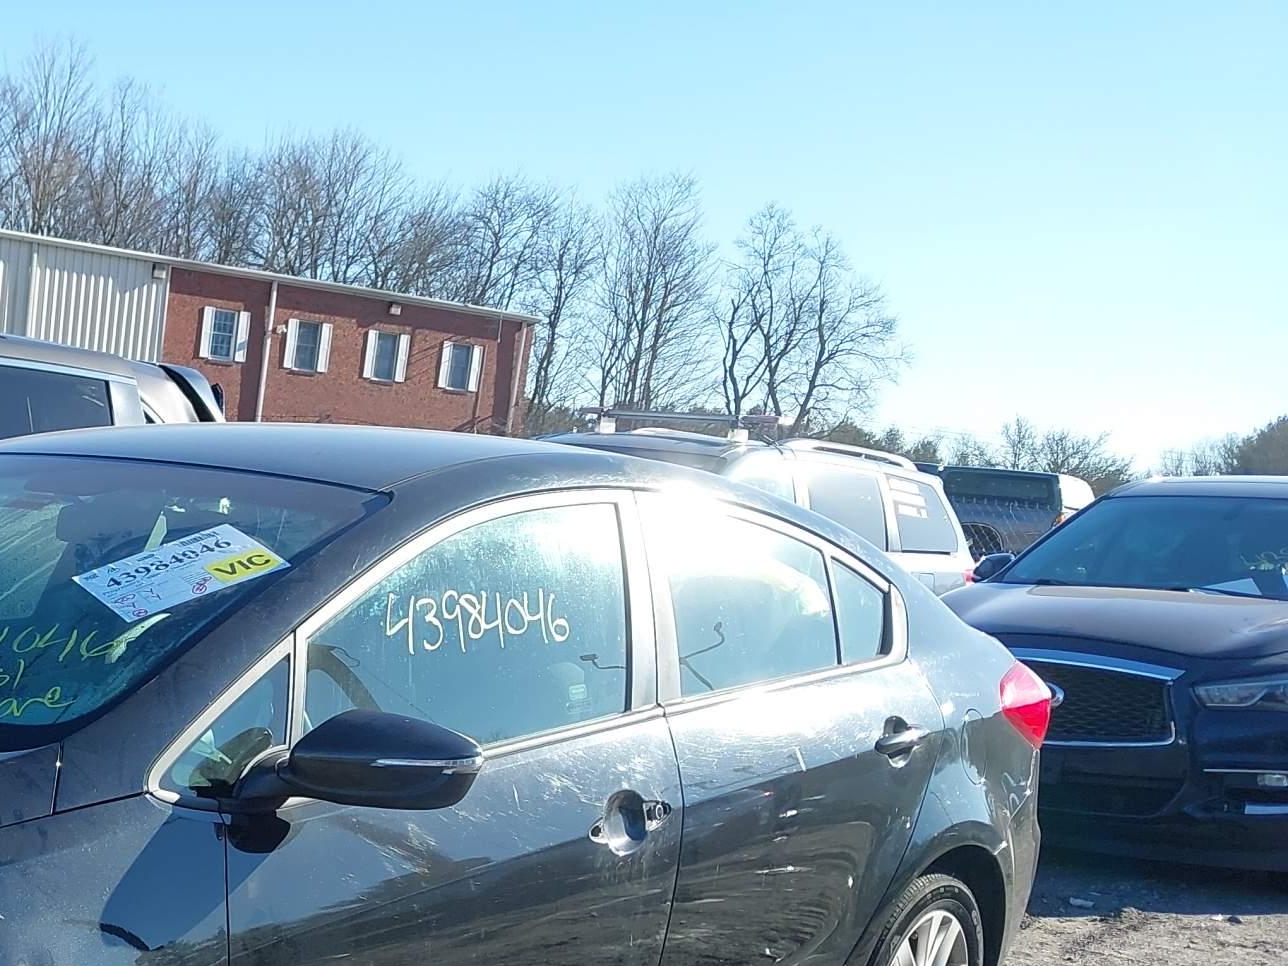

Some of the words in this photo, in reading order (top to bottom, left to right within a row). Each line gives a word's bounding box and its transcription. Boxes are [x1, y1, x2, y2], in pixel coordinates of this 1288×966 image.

[106, 539, 232, 589] 43984046
[213, 554, 271, 576] VIC
[385, 587, 570, 655] 43984046
